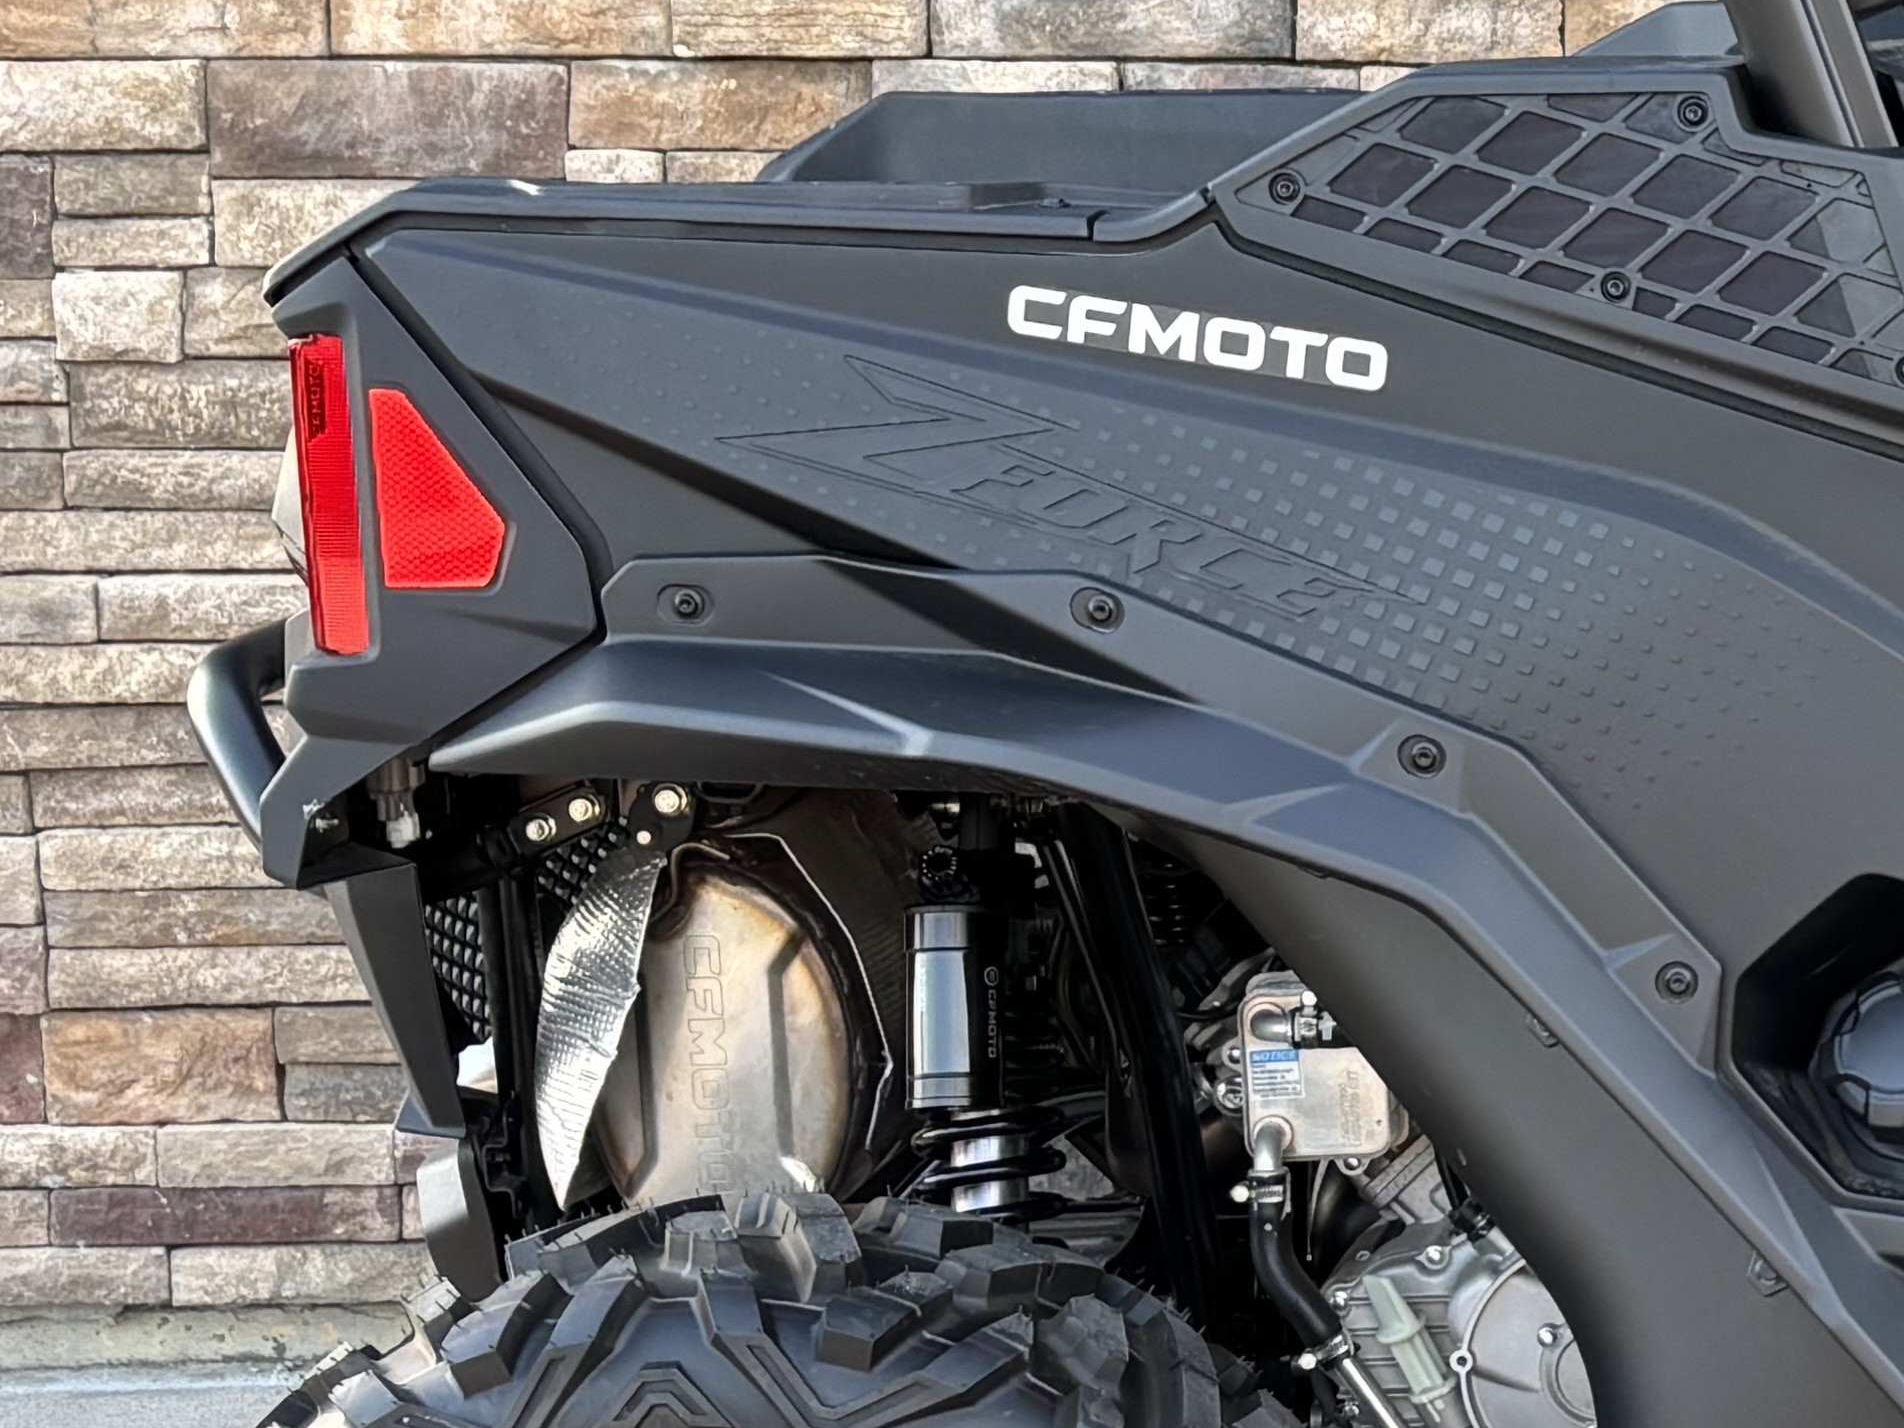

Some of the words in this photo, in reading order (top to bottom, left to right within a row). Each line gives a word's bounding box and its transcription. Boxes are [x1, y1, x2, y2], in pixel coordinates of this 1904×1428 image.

[1007, 285, 1388, 391] CFMOTO
[683, 935, 736, 1192] CFMOTO
[988, 989, 997, 1058] CFMOTO
